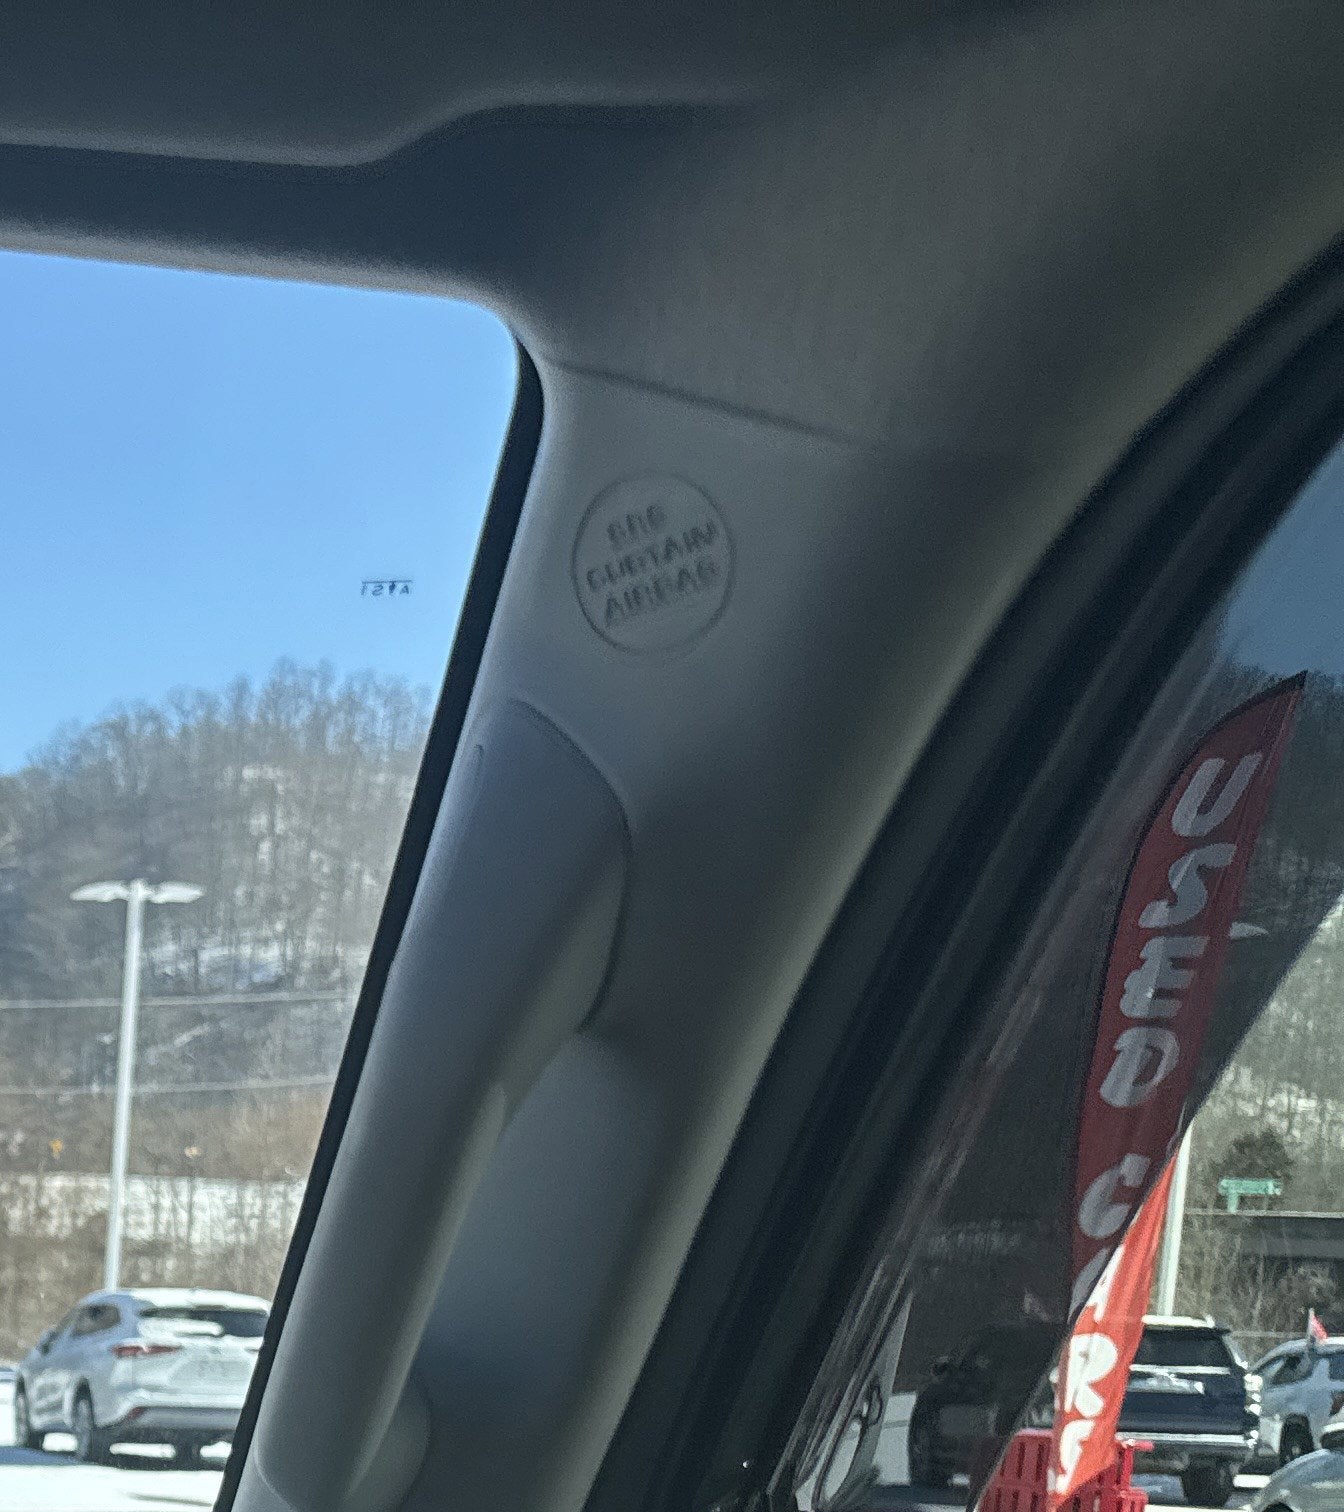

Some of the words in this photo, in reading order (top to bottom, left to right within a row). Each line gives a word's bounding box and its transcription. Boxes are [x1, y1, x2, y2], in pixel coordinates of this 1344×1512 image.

[585, 519, 717, 594] CURTAIN
[603, 558, 719, 630] AIRBAG
[1098, 750, 1263, 1109] USED
